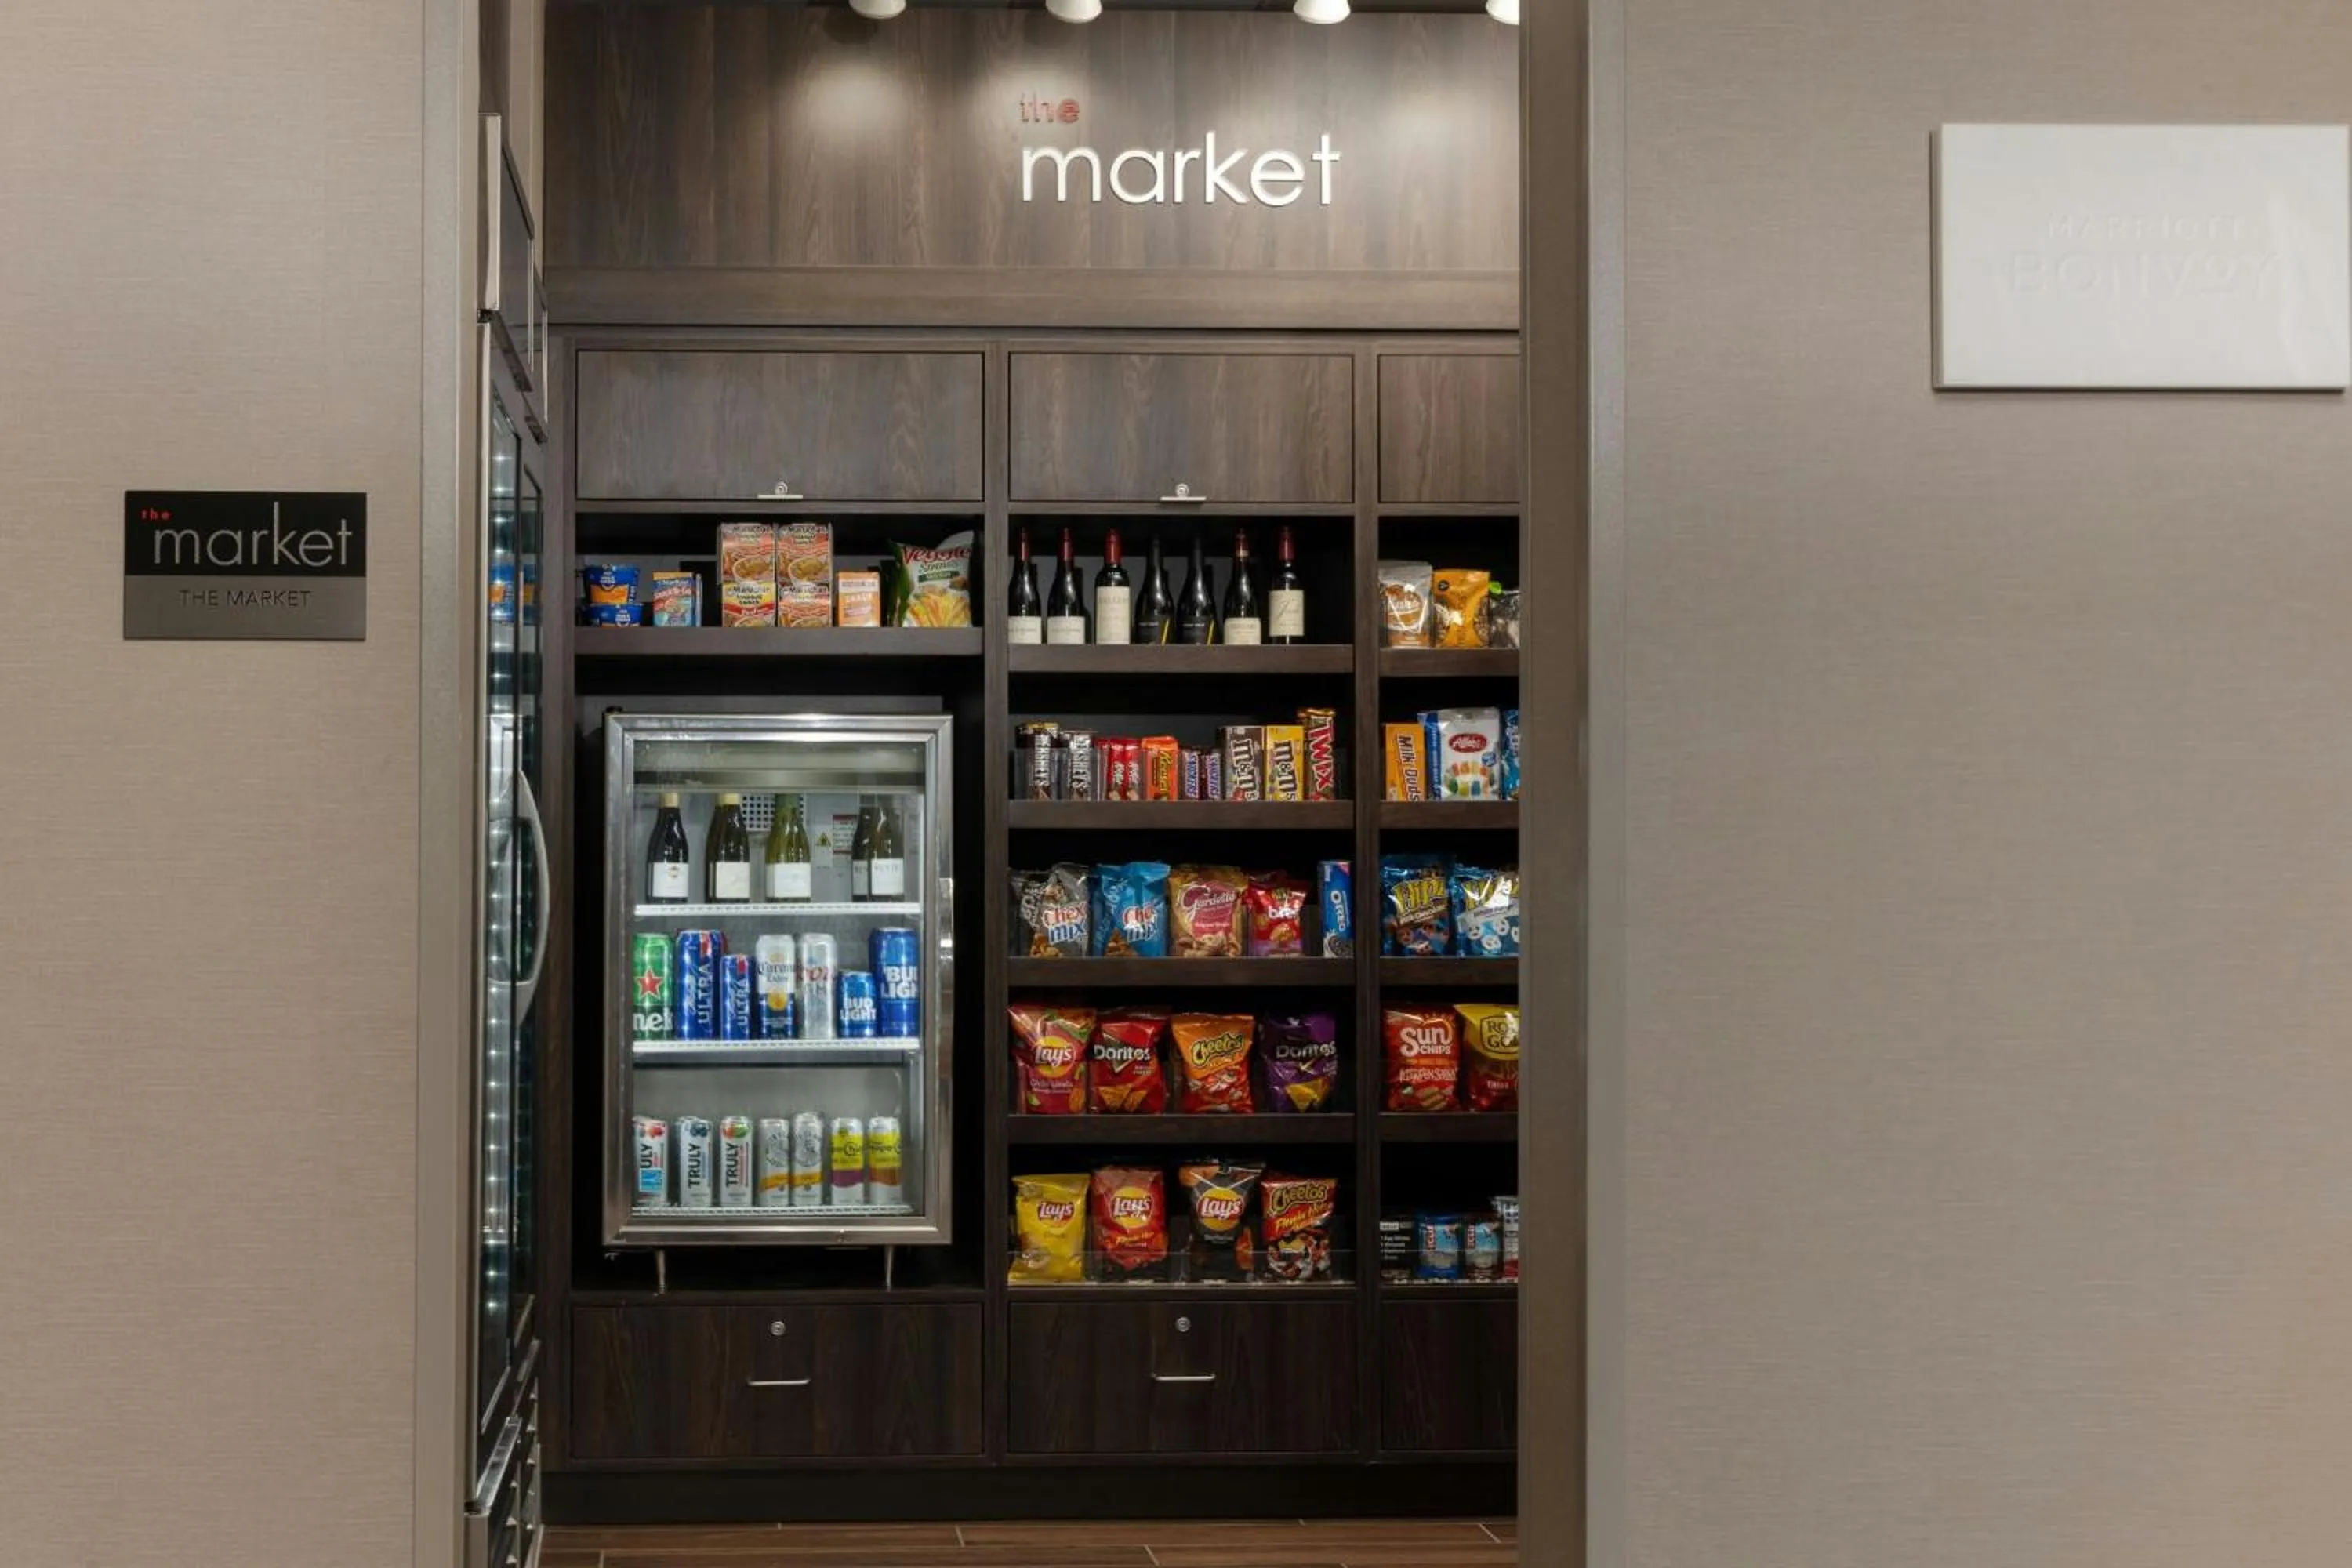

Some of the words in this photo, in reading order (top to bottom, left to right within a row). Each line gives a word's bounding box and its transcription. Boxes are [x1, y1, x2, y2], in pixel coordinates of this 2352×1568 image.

[1020, 94, 1080, 122] the
[1022, 130, 1341, 206] market
[141, 508, 170, 520] the
[154, 501, 352, 567] market
[180, 590, 219, 607] THE
[227, 590, 312, 607] MARKET
[1308, 724, 1334, 793] TWIX
[1041, 902, 1088, 928] Chex
[697, 964, 712, 1025] ULTRA
[737, 977, 750, 1026] ULTRA
[1093, 1044, 1152, 1062] Doritos
[1191, 1033, 1243, 1067] Cheetos
[1276, 1041, 1337, 1059] Doritos
[1399, 1026, 1451, 1058] Sun
[688, 1143, 701, 1189] TRULY
[726, 1143, 739, 1188] TRULY
[1271, 1182, 1327, 1214] Cheetos
